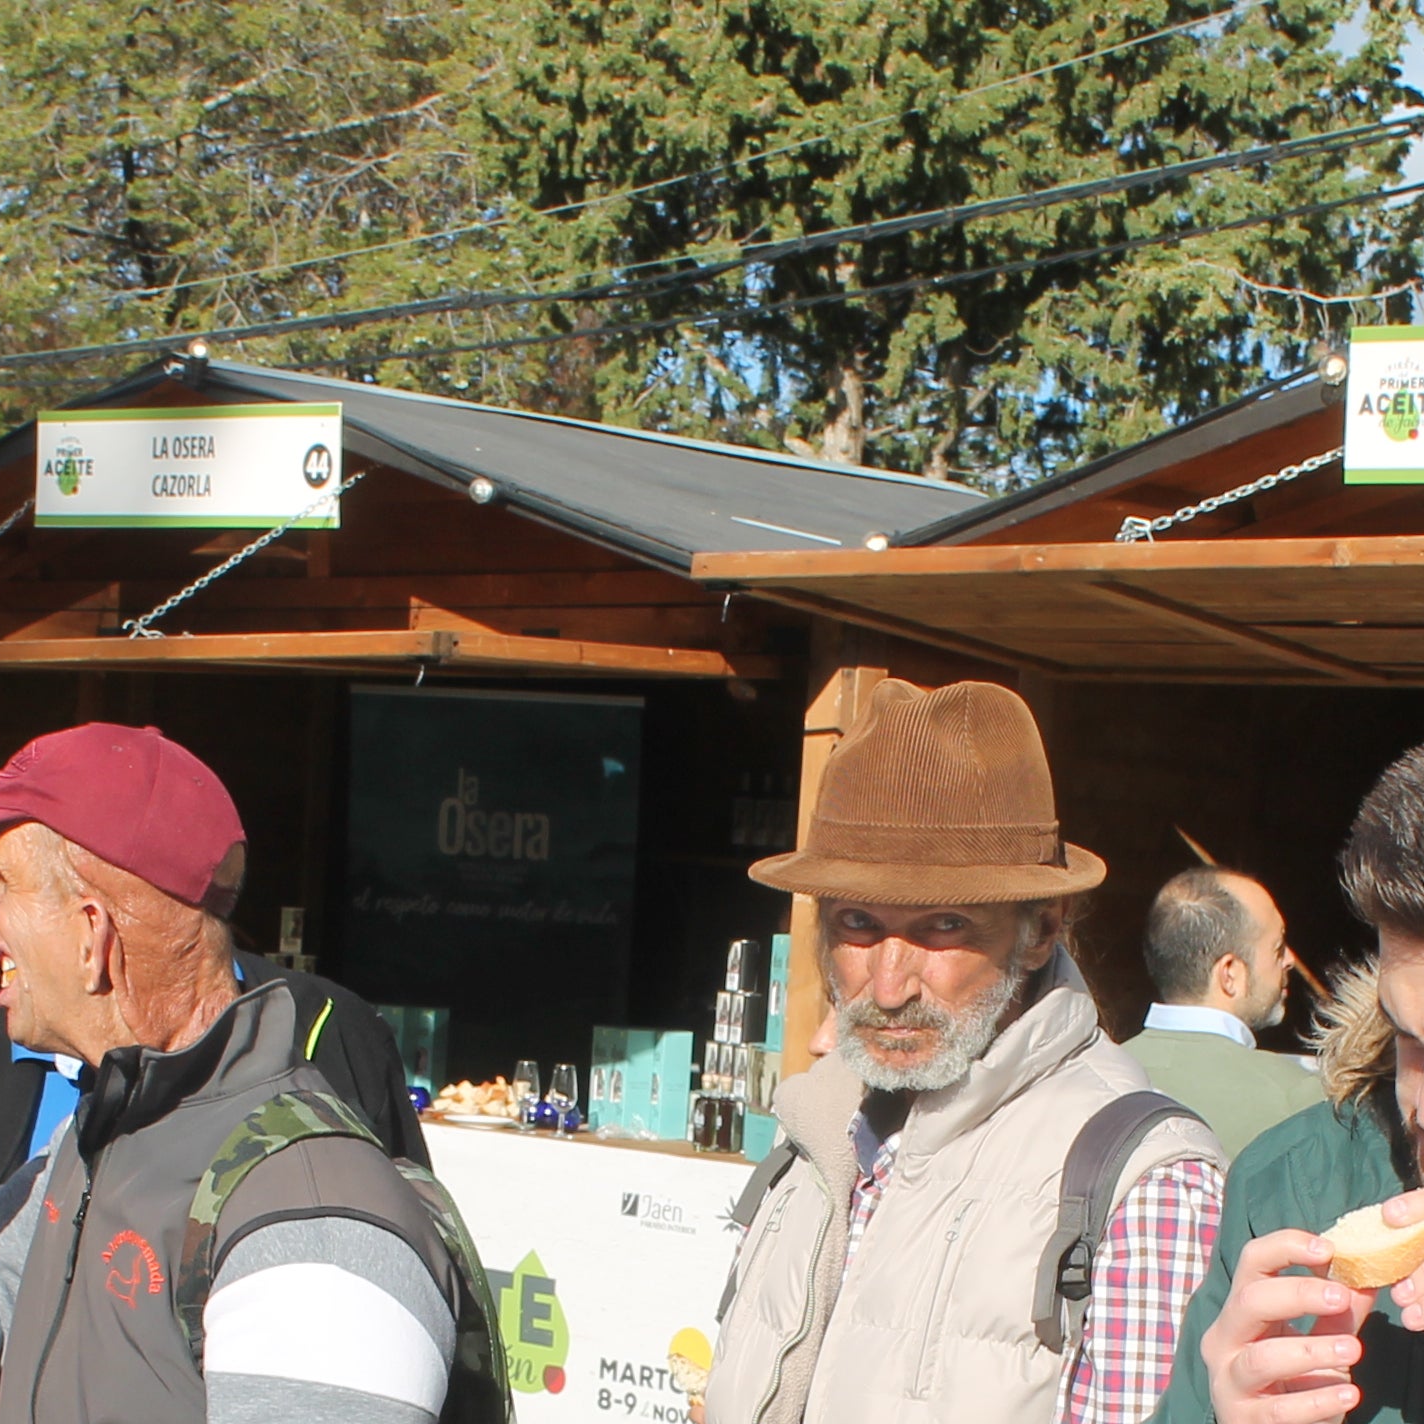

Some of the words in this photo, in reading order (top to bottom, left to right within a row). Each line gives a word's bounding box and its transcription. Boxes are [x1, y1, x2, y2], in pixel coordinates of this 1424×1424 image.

[151, 437, 169, 460] LA
[172, 436, 216, 459] OSERA
[43, 459, 95, 476] ACEITE
[304, 451, 331, 479] 44
[151, 475, 212, 498] CAZORLA
[457, 767, 480, 806] la
[437, 797, 551, 861] Osera
[641, 1194, 683, 1222] Jaén
[597, 1387, 637, 1415] 8-9
